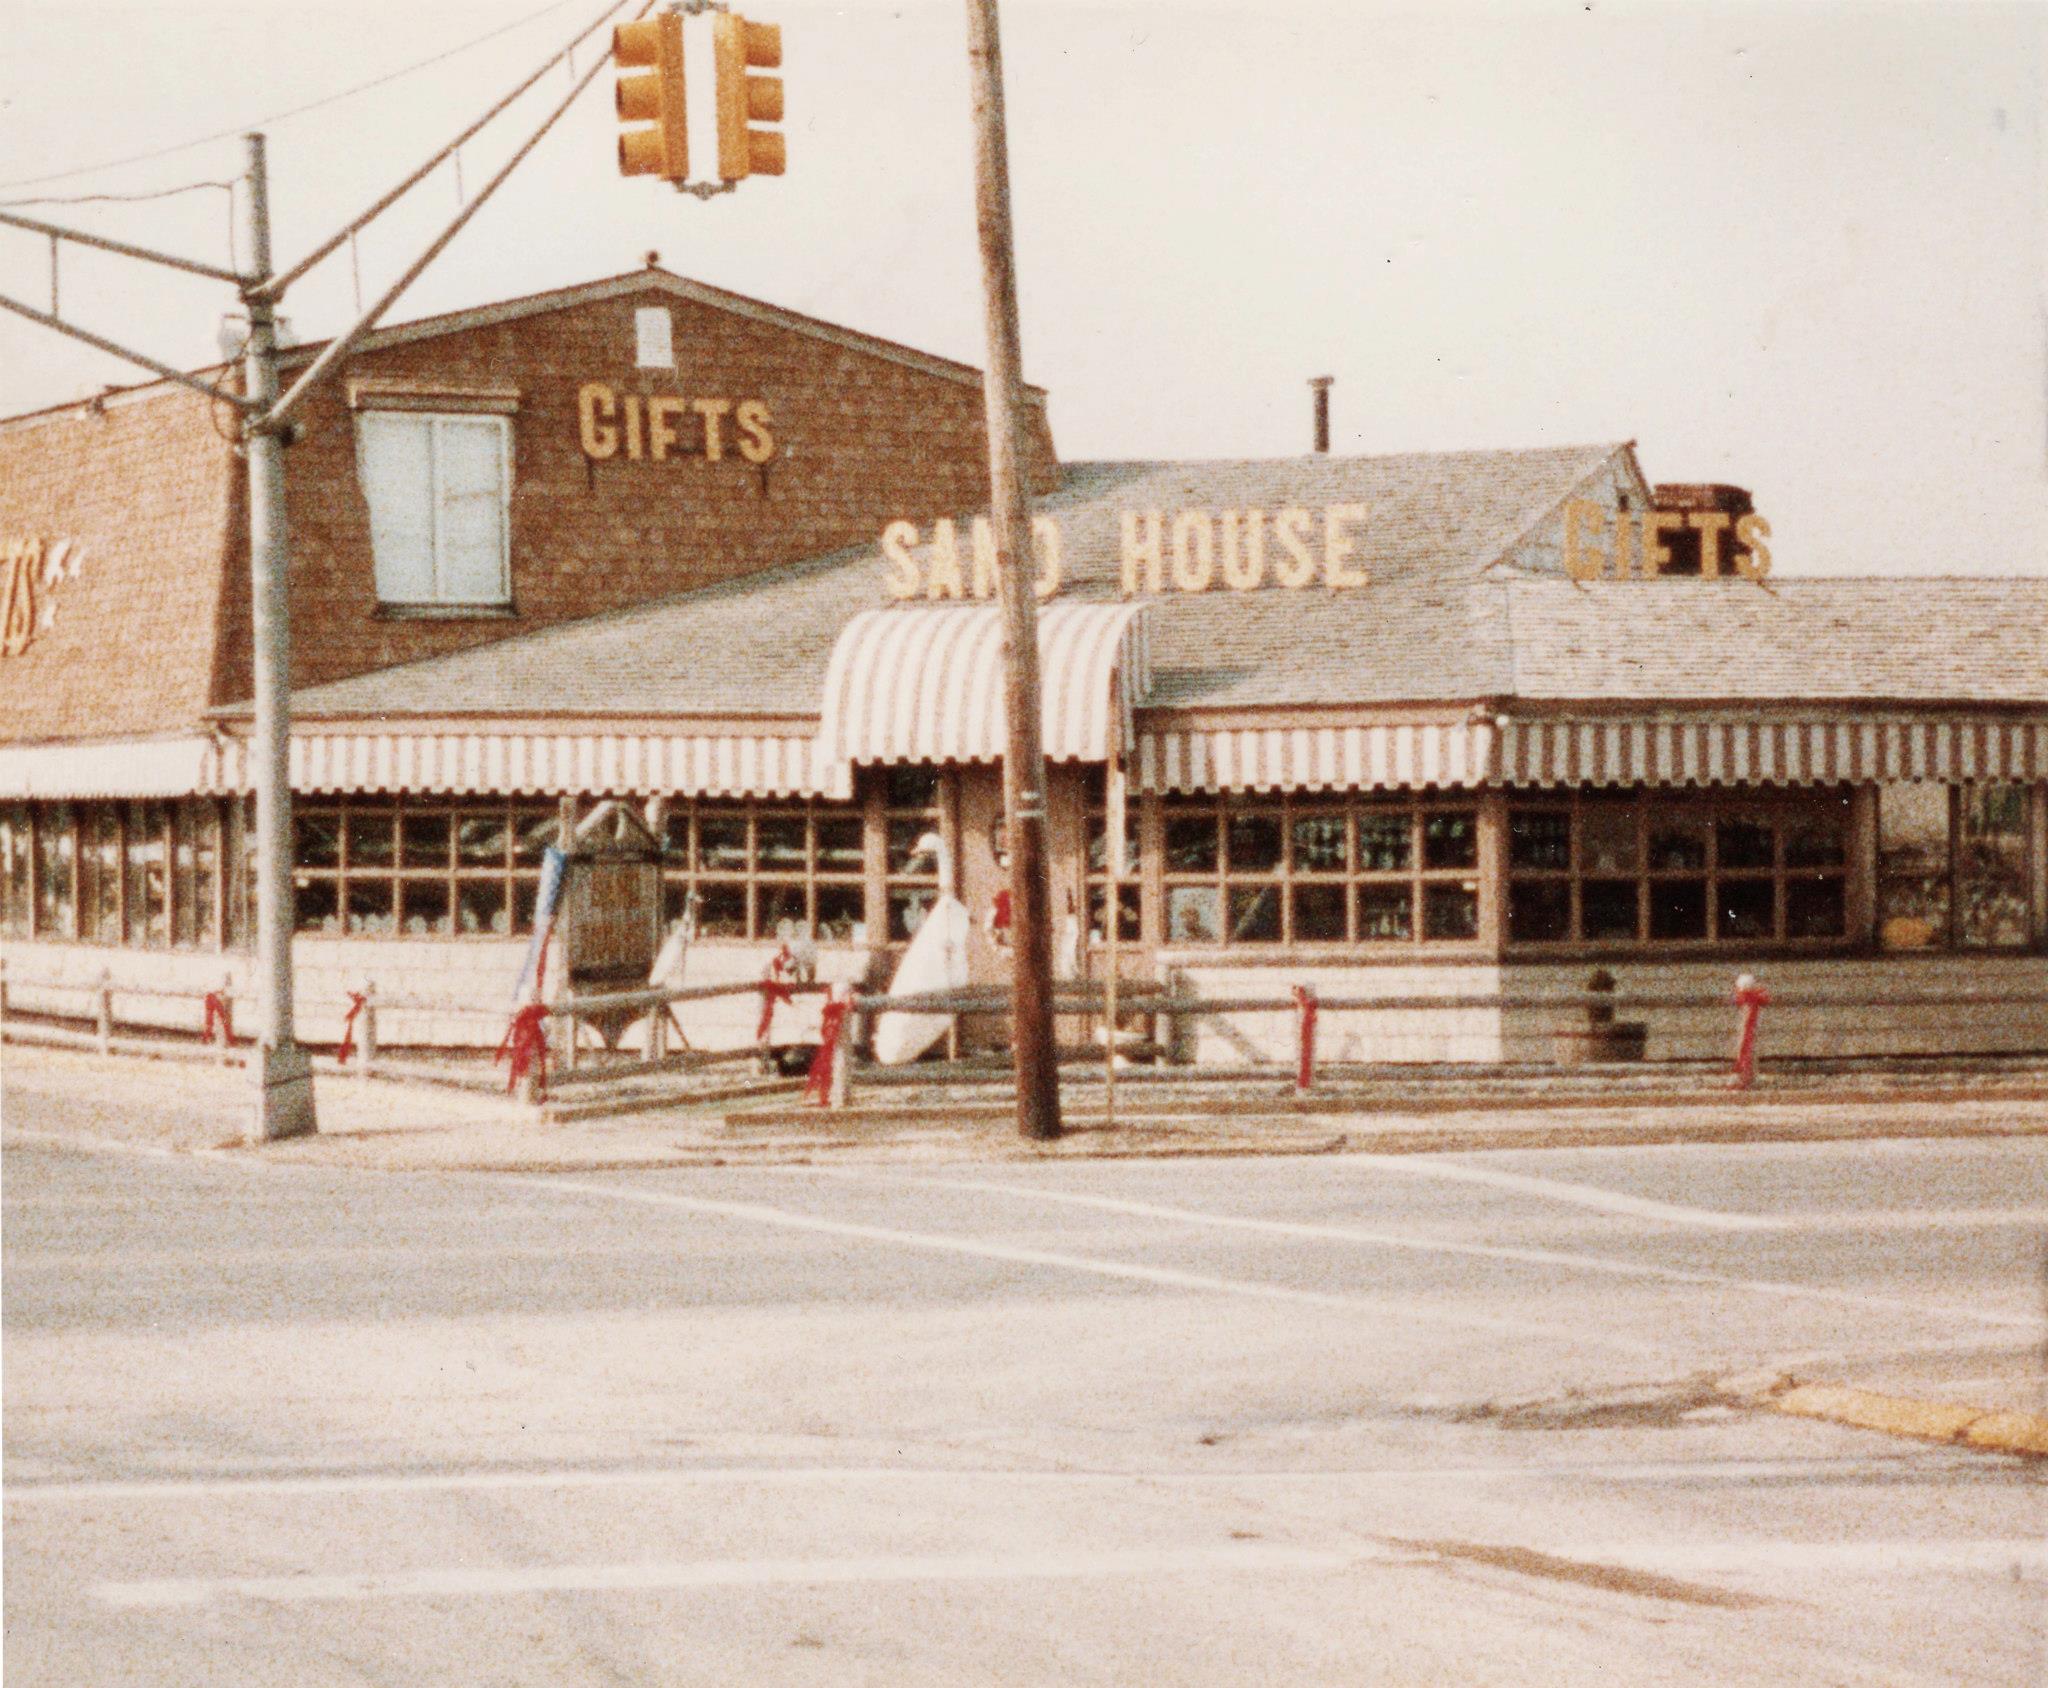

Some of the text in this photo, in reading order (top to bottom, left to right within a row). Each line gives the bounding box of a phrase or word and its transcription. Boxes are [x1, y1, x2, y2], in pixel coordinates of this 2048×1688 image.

[578, 383, 774, 463] GIFTS
[1120, 503, 1368, 593] HOUSE
[1564, 499, 1772, 581] GIFTS
